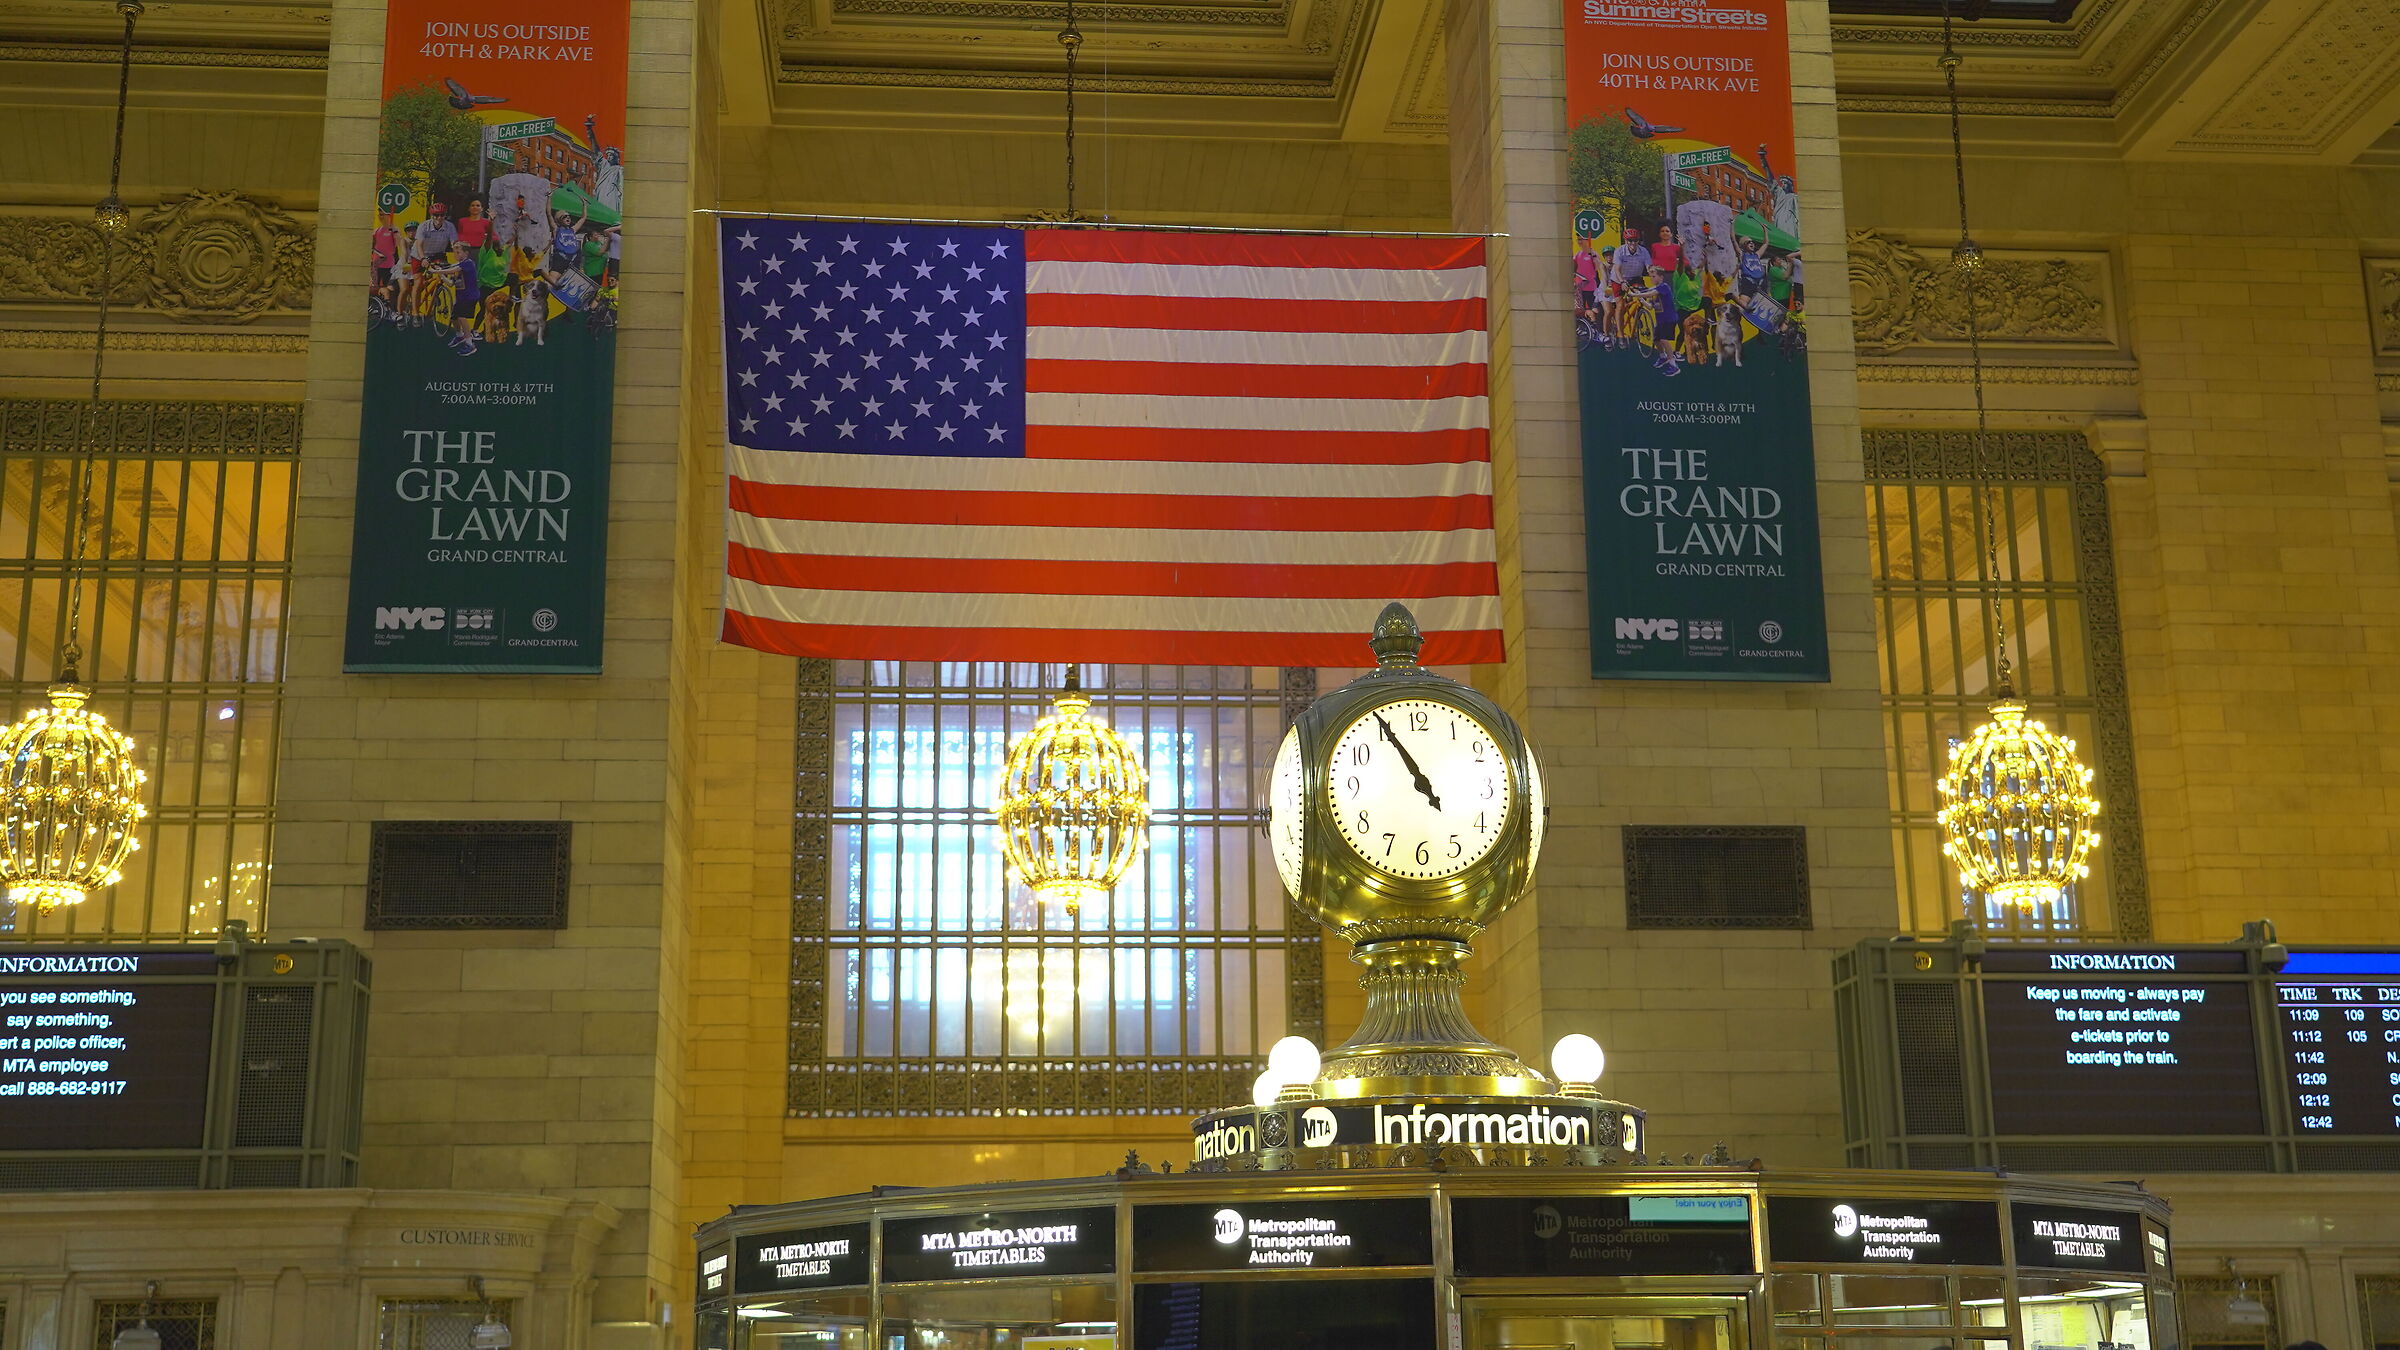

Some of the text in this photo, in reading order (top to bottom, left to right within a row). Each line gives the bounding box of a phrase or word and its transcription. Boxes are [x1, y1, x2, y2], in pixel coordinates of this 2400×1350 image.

[426, 22, 590, 41] JOIN US OUTSIDE
[420, 43, 593, 61] 40TH & PARK AVE
[1602, 54, 1754, 72] JOIN US OUTSIDE
[1599, 74, 1759, 93] 40TH & PARK AVE
[500, 122, 546, 137] CAR-FREE
[493, 148, 508, 160] FUN
[1681, 151, 1722, 166] CAR-FREE
[1676, 175, 1691, 188] FUN
[382, 192, 405, 206] GO
[1579, 218, 1600, 231] GO
[425, 382, 554, 393] AUGUST 10TH & 17TH
[1637, 401, 1755, 413] AUGUST 10TH & 17TH
[403, 430, 496, 464] THE
[1621, 448, 1708, 481] THE
[396, 469, 571, 503] GRAND
[1620, 484, 1782, 519] GRAND
[429, 507, 570, 541] LAWN
[1656, 522, 1783, 556] LAWN
[428, 550, 568, 563] GRAND CENTRAL
[1656, 563, 1785, 577] GRAND CENTRAL
[376, 607, 445, 630] NYC
[457, 615, 493, 629] DOT
[1615, 618, 1679, 641] NYC
[1689, 627, 1723, 640] DOT
[509, 639, 579, 647] GRAND CENTRAL
[1409, 712, 1429, 732] 12
[1451, 721, 1457, 741] 1
[1353, 743, 1370, 766] 10
[1473, 742, 1484, 763] 2
[1348, 776, 1360, 800] 9
[1481, 777, 1493, 800] 3
[1358, 810, 1370, 835] 8
[1473, 811, 1487, 833] 4
[1383, 833, 1396, 856] 7
[1416, 841, 1429, 865] 6
[1448, 835, 1462, 859] 5
[2050, 955, 2175, 970] INFORMATION
[1, 990, 136, 1007] you see something,
[2026, 986, 2060, 1003] Keep
[2063, 989, 2078, 1000] us
[2081, 987, 2126, 1003] moving
[2137, 987, 2179, 1003] always
[2182, 989, 2205, 1003] pay
[2280, 988, 2318, 1001] TIME
[2332, 988, 2363, 1001] TRK
[7, 1013, 112, 1029] say something.
[2055, 1008, 2181, 1022] the fare and activate
[2290, 1009, 2400, 1022] 11:09 109 SO
[22, 1038, 31, 1049] a
[34, 1036, 76, 1053] police
[80, 1035, 126, 1051] officer,
[2071, 1029, 2170, 1045] e-tickets prior to
[2292, 1031, 2322, 1043] 11:12
[2347, 1031, 2368, 1043] 105
[3, 1058, 109, 1075] MTA employee
[2066, 1050, 2178, 1067] boarding the train.
[2295, 1052, 2325, 1064] 11:42
[2297, 1073, 2400, 1085] 12:09 S
[0, 1081, 127, 1096] call 888-682-9117
[2299, 1094, 2330, 1107] 12:12
[1302, 1118, 1331, 1142] MTA
[1374, 1104, 1590, 1145] Information
[2302, 1116, 2333, 1128] 12:42
[1249, 1218, 1336, 1234] Metropolitan
[1568, 1216, 1654, 1229] Metropolitan
[1860, 1215, 1928, 1230] Metropolitan
[2033, 1221, 2120, 1240] MTA METRO-NORTH
[401, 1230, 535, 1248] CUSTOMER SERVICE
[922, 1225, 1077, 1250] MTA METRO-NORTH
[1249, 1233, 1351, 1249] Transportation
[1568, 1232, 1670, 1245] Transportation
[1861, 1230, 1940, 1245] Transportation
[760, 1240, 849, 1262] MTA METRO-NORTH
[952, 1247, 1046, 1267] TIMETABLES
[1249, 1249, 1313, 1265] Authority
[1570, 1248, 1632, 1261] Authority
[1864, 1245, 1914, 1260] Authority
[2053, 1241, 2106, 1258] TIMETABLES
[776, 1260, 830, 1278] TIMETABLES
